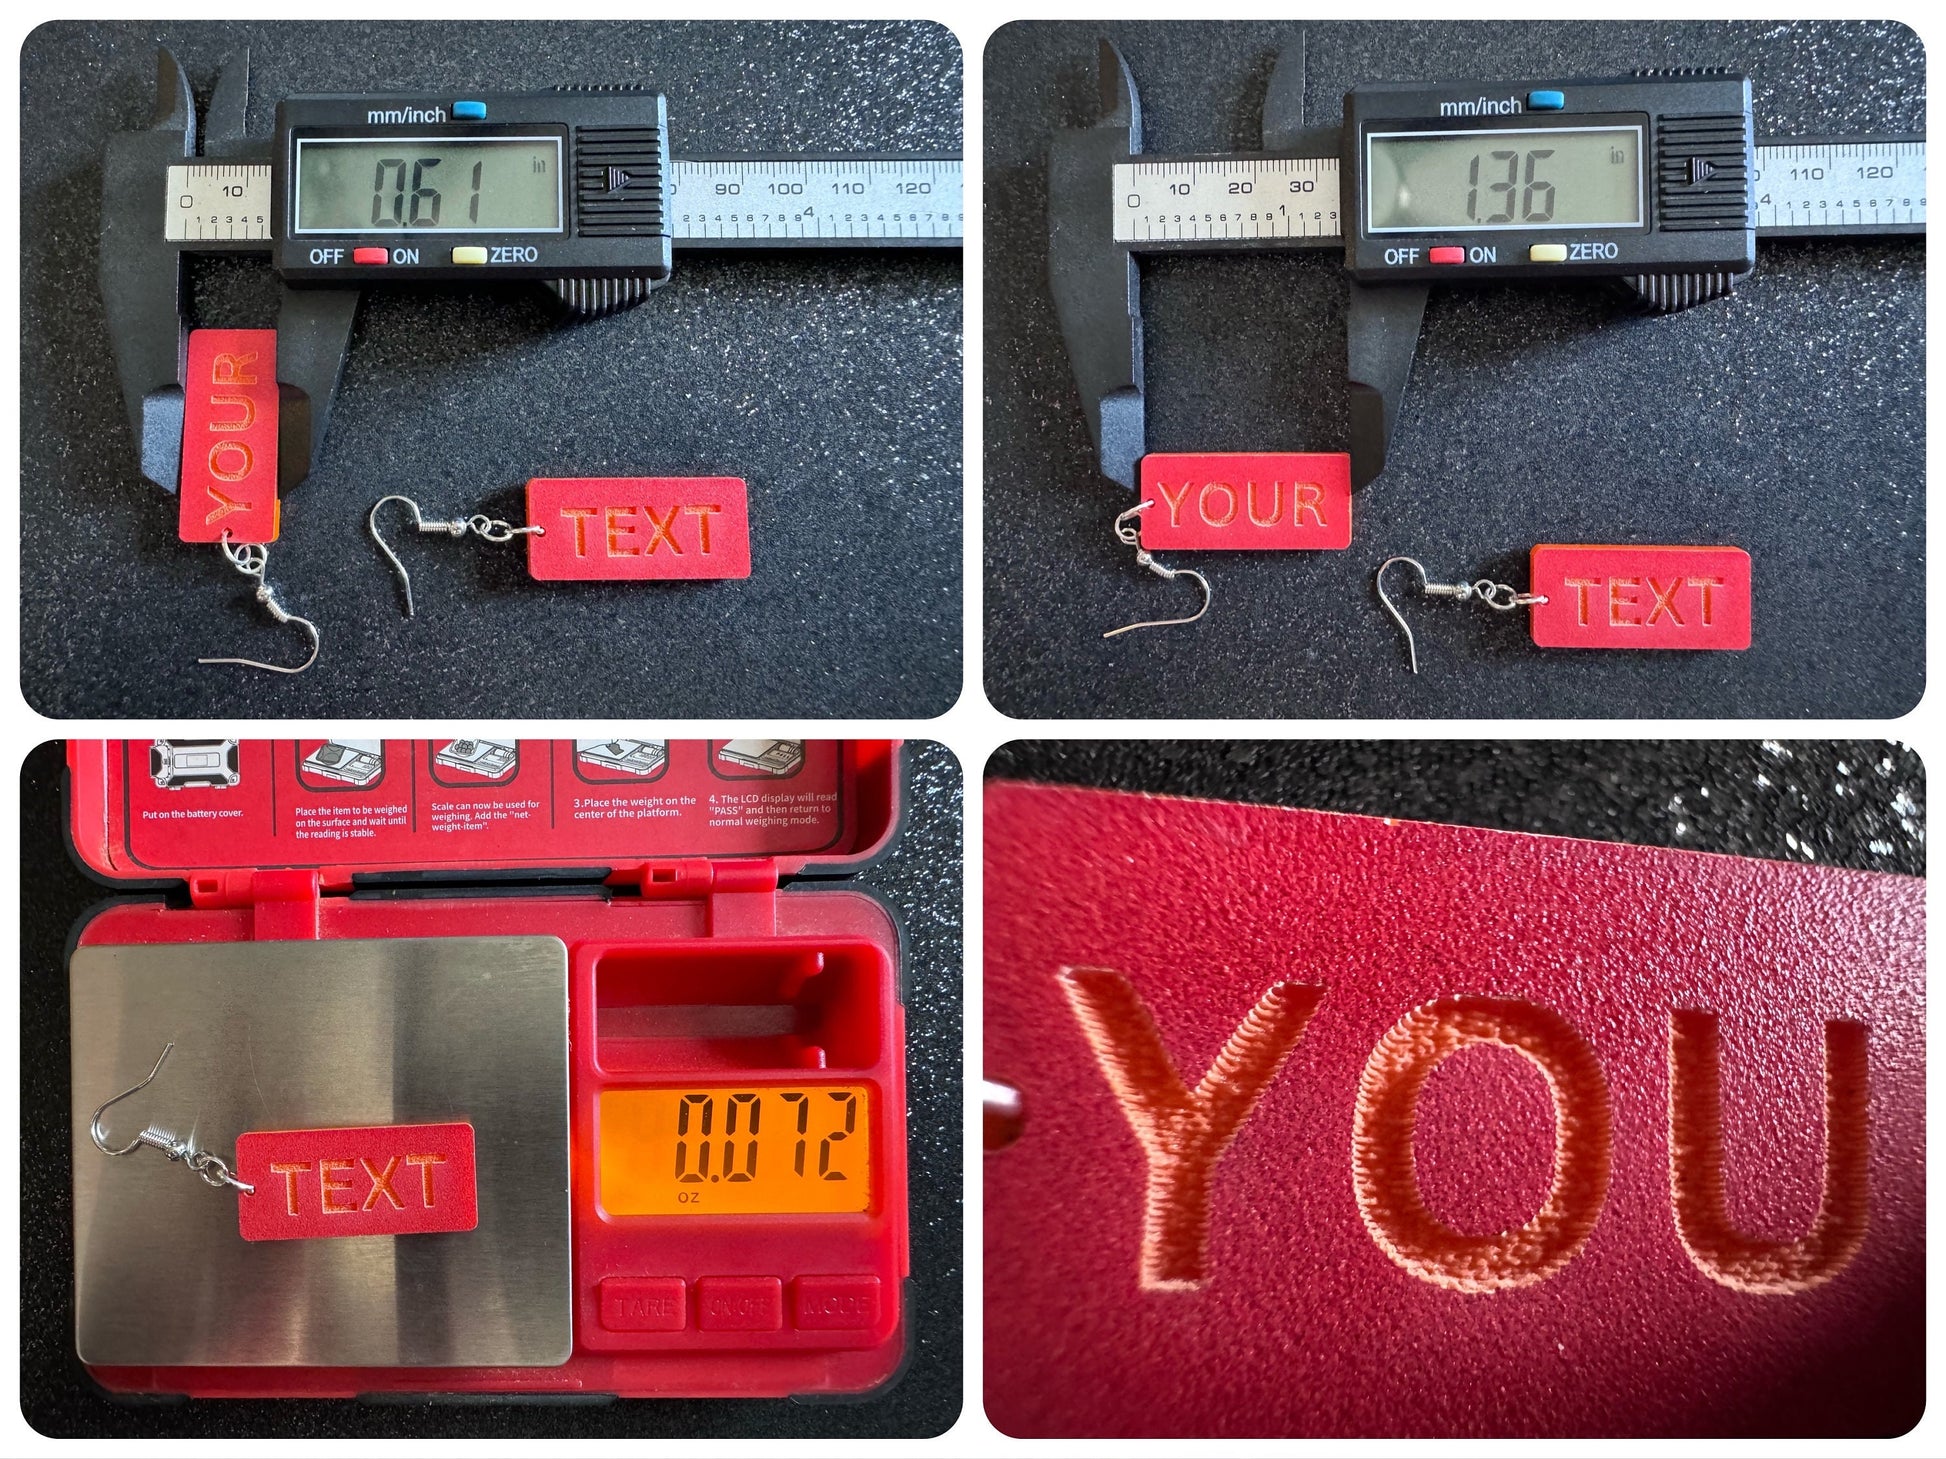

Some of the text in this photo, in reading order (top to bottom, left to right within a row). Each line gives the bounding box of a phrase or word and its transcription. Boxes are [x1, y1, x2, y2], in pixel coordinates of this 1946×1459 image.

[1440, 96, 1522, 116] mm/inch
[367, 107, 446, 124] mm/inch
[1790, 167, 1893, 180] 110 120
[371, 156, 546, 227] 0.61 in
[715, 184, 740, 194] 90
[768, 183, 803, 195] 100
[832, 183, 865, 194] 110
[896, 183, 931, 194] 120
[1466, 146, 1624, 224] 1.36 in
[180, 186, 242, 208] 0 10
[1128, 181, 1314, 208] 0 10 20 30
[1760, 194, 1771, 205] 4
[1803, 201, 1810, 209] 2
[1819, 200, 1827, 208] 3
[1836, 200, 1843, 208] 4
[1853, 200, 1861, 208] 5
[1869, 199, 1877, 207] 6
[1887, 199, 1894, 207] 7
[1903, 198, 1911, 206] 8
[731, 214, 738, 222] 5
[746, 214, 754, 222] 6
[762, 214, 769, 222] 7
[778, 214, 786, 222] 8
[804, 206, 814, 217] 4
[1159, 215, 1166, 223] 2
[1189, 214, 1196, 222] 4
[1205, 214, 1212, 222] 5
[1219, 214, 1227, 222] 6
[1235, 213, 1241, 221] 7
[1250, 213, 1257, 221] 8
[1280, 204, 1285, 216] 1
[1314, 212, 1321, 220] 2
[309, 248, 344, 265] OFF
[393, 248, 419, 265] ON
[490, 246, 538, 264] ZERO
[1384, 248, 1420, 265] OFF
[1469, 246, 1497, 264] ON
[1569, 242, 1618, 261] ZERO
[206, 352, 258, 525] YOUR
[1157, 481, 1328, 528] YOUR
[560, 504, 721, 558] TEXT
[1564, 576, 1724, 627] TEXT
[432, 802, 454, 811] Scale
[472, 802, 491, 810] now
[493, 801, 504, 810] be
[505, 800, 526, 808] used
[528, 800, 540, 808] for
[612, 798, 628, 807] the
[630, 797, 663, 808] weight
[666, 798, 678, 806] on
[680, 796, 697, 805] the
[709, 792, 838, 804] 4. The LCD display will read
[143, 810, 244, 820] Put on the battery cover.
[296, 804, 408, 816] Place the item to be weighed
[432, 812, 473, 823] weighing.
[474, 812, 492, 820] Add
[574, 808, 682, 819] center of the platform.
[709, 804, 831, 815] "PASS" and then return to
[296, 816, 407, 828] on the surface and wait until
[709, 816, 820, 827] normal weighing mode.
[296, 828, 376, 840] the reading is stable.
[675, 1092, 856, 1183] 0.072
[1055, 966, 1871, 1295] YOU
[270, 1153, 447, 1217] TEXT
[614, 1297, 678, 1318] TARE
[802, 1296, 870, 1316] MODE
